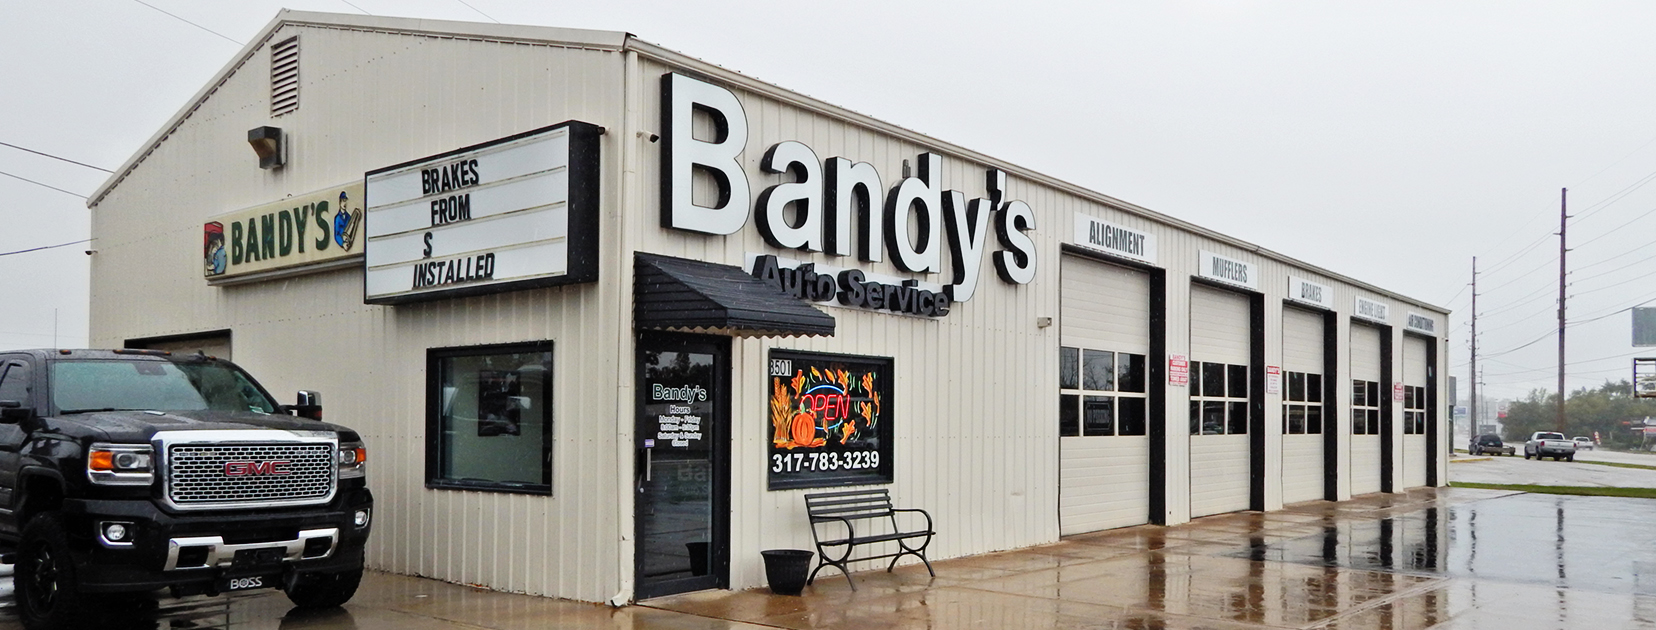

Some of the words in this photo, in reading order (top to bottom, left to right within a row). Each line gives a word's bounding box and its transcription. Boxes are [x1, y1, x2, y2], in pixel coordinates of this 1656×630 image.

[422, 159, 480, 195] BRAKES
[661, 72, 1037, 303] Bandy's
[431, 194, 471, 227] FROM
[231, 201, 330, 266] BANDY'S
[423, 232, 433, 259] S
[1089, 220, 1145, 257] ALIGNMENT
[413, 253, 496, 289] INSTALLED
[1212, 256, 1248, 284] MUFFLERS
[753, 255, 836, 302] Auto
[838, 269, 951, 317] Service
[1301, 281, 1323, 304] BRAKES
[653, 383, 707, 404] Bandy's
[658, 415, 680, 425] Monday
[683, 415, 701, 425] Friday
[669, 404, 691, 414] Hours
[799, 394, 850, 420] OPEN
[657, 432, 680, 441] Saturday
[683, 432, 702, 441] Sunday
[671, 439, 689, 447] Closed
[225, 461, 291, 476] GMC
[772, 451, 880, 473] 317-783-3239
[230, 576, 263, 590] BOSS
